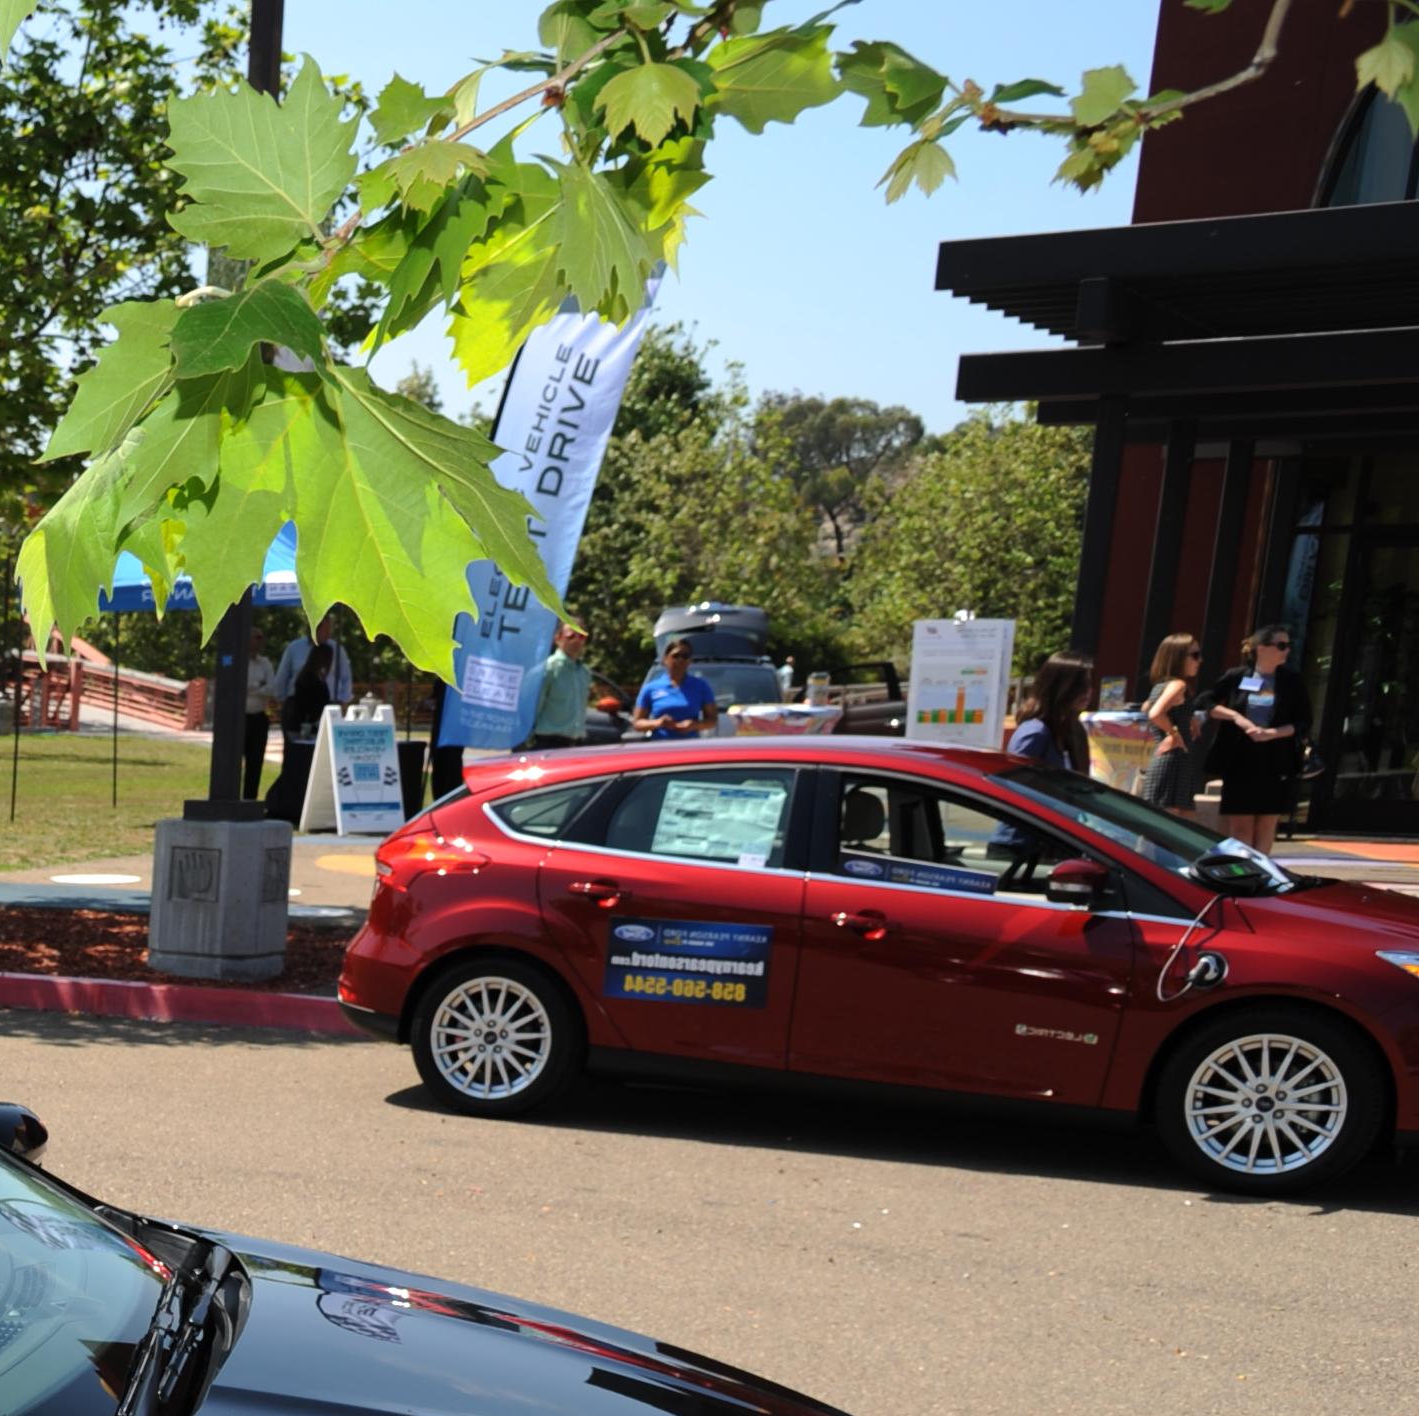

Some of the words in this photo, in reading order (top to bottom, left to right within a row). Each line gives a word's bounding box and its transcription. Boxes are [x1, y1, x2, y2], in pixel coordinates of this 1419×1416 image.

[498, 517, 547, 641] TET
[536, 353, 602, 498] DRIVE
[519, 343, 573, 472] VEHICLE
